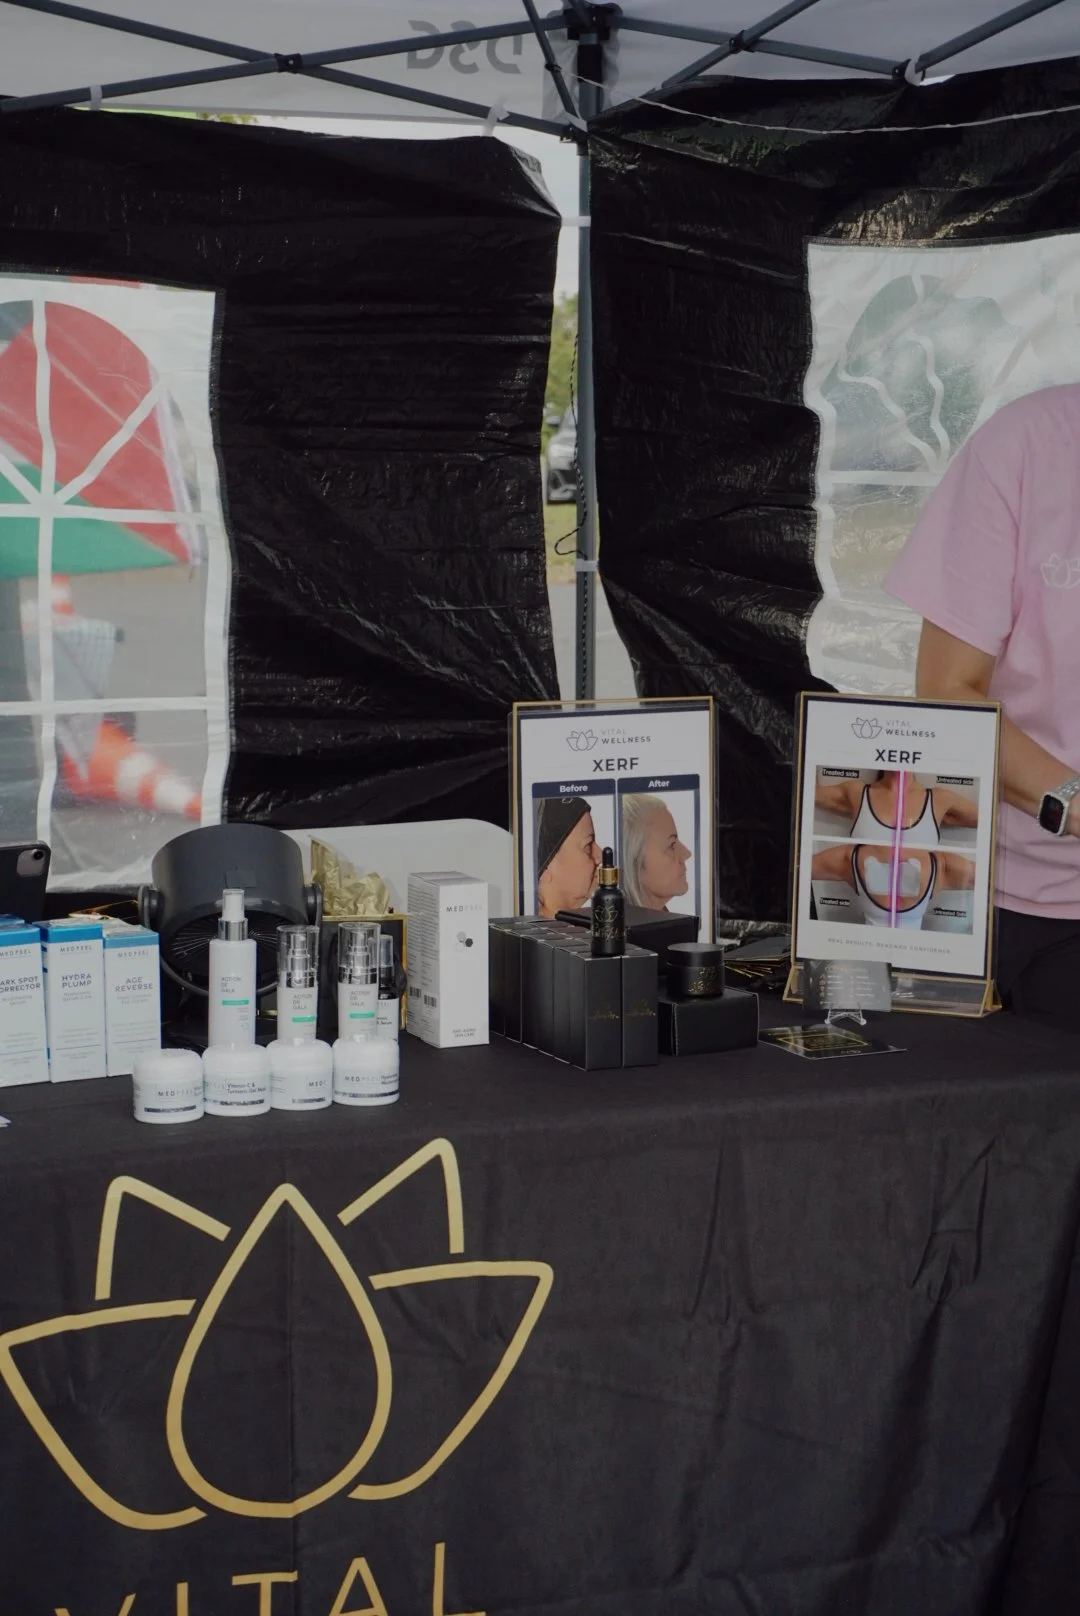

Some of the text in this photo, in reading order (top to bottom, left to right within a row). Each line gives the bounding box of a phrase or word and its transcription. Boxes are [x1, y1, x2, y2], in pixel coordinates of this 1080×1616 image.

[885, 719, 912, 728] VITAL
[600, 727, 627, 736] VITAL
[885, 728, 937, 738] WELLNESS
[600, 735, 652, 745] WELLNESS
[874, 748, 923, 765] XERF
[592, 757, 640, 773] XERF
[822, 768, 858, 778] Treated side
[648, 779, 671, 788] After
[559, 784, 589, 793] Before
[60, 945, 93, 953] MEDPEEL
[18, 975, 39, 984] SPOT
[61, 973, 92, 982] HYDRA
[125, 976, 144, 984] AGE
[0, 982, 41, 993] ORRECTOR
[62, 980, 92, 989] PLUMP
[115, 982, 153, 992] REVERSE
[54, 1542, 487, 1616] TAL
